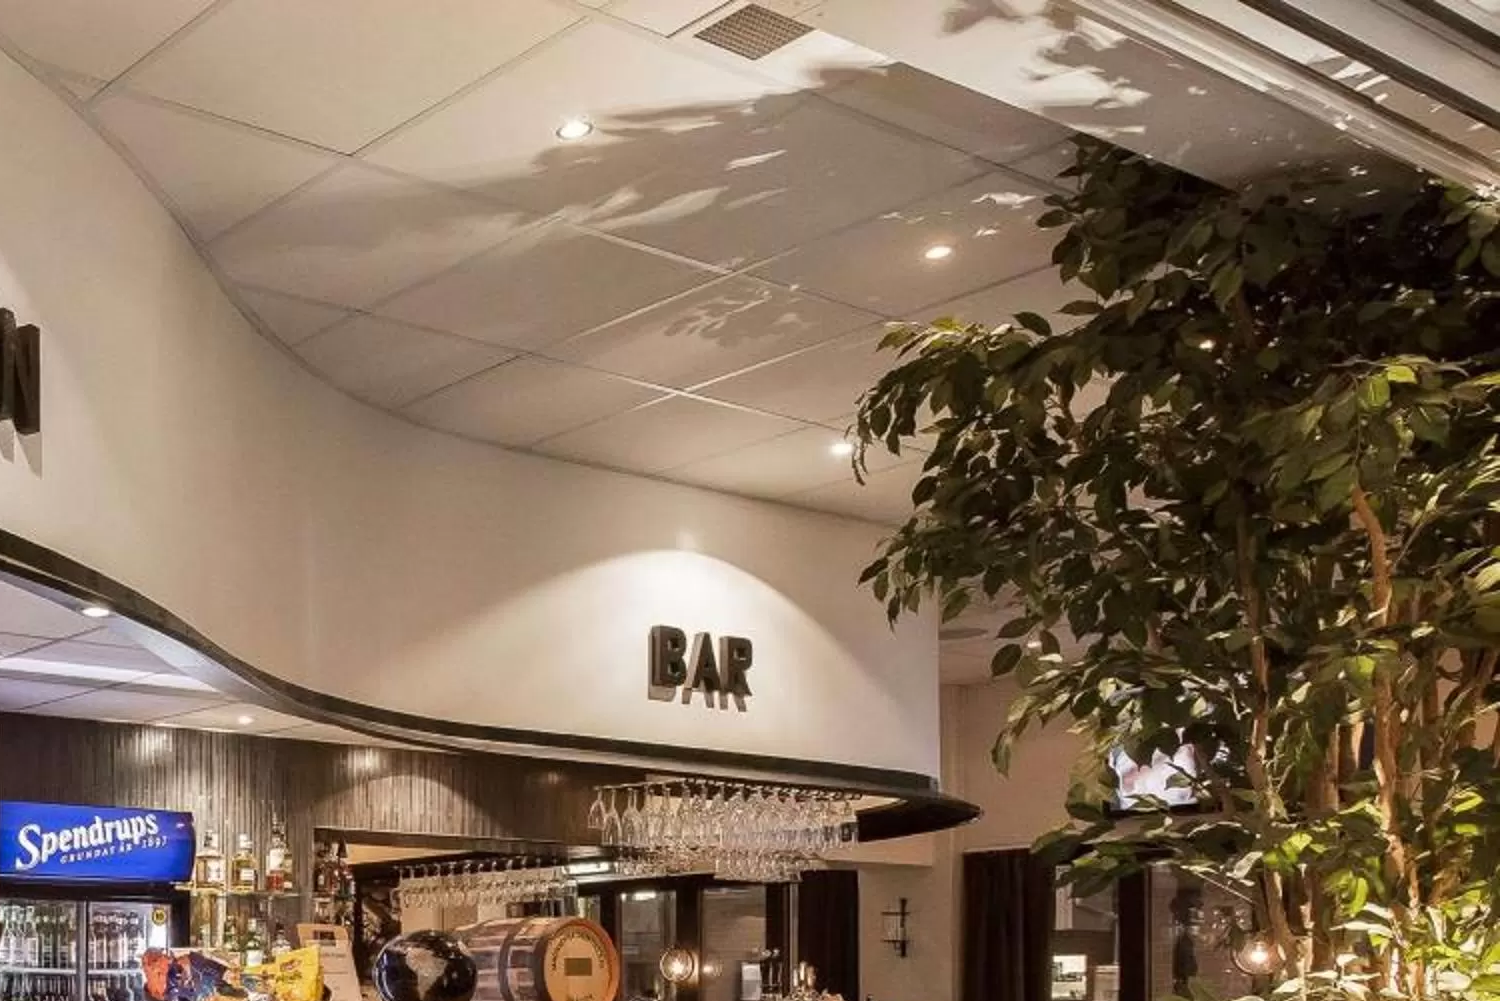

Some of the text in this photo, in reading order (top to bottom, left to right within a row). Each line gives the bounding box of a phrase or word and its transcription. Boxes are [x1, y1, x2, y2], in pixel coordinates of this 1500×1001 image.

[650, 625, 752, 697] BAR
[15, 813, 159, 871] Spendrups
[60, 846, 116, 864] GRUNDAT
[141, 836, 168, 849] 1897
